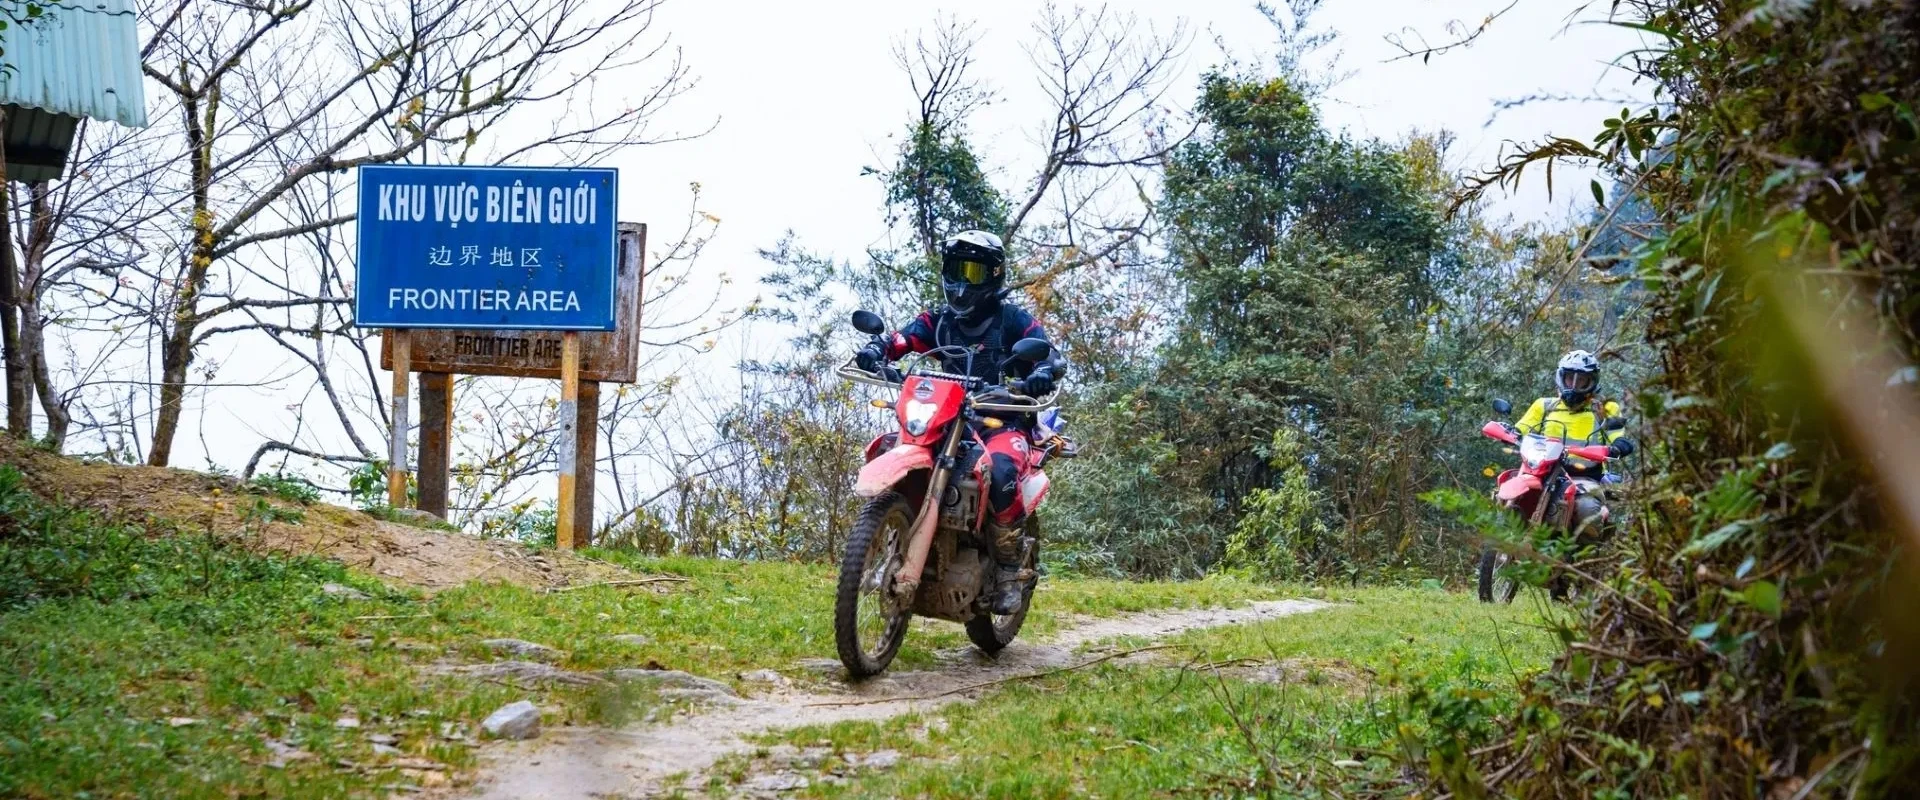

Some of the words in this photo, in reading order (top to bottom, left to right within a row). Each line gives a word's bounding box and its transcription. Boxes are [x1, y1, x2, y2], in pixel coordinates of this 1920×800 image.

[378, 184, 426, 221] KHU
[433, 181, 479, 228] VỰC
[485, 180, 543, 223] BIÊN
[548, 180, 597, 224] GIỚI
[428, 246, 543, 267] 边界地区
[388, 288, 511, 311] FRONTIER
[514, 290, 581, 312] AREA
[454, 335, 529, 357] FRONTIER
[533, 338, 562, 359] ARE
